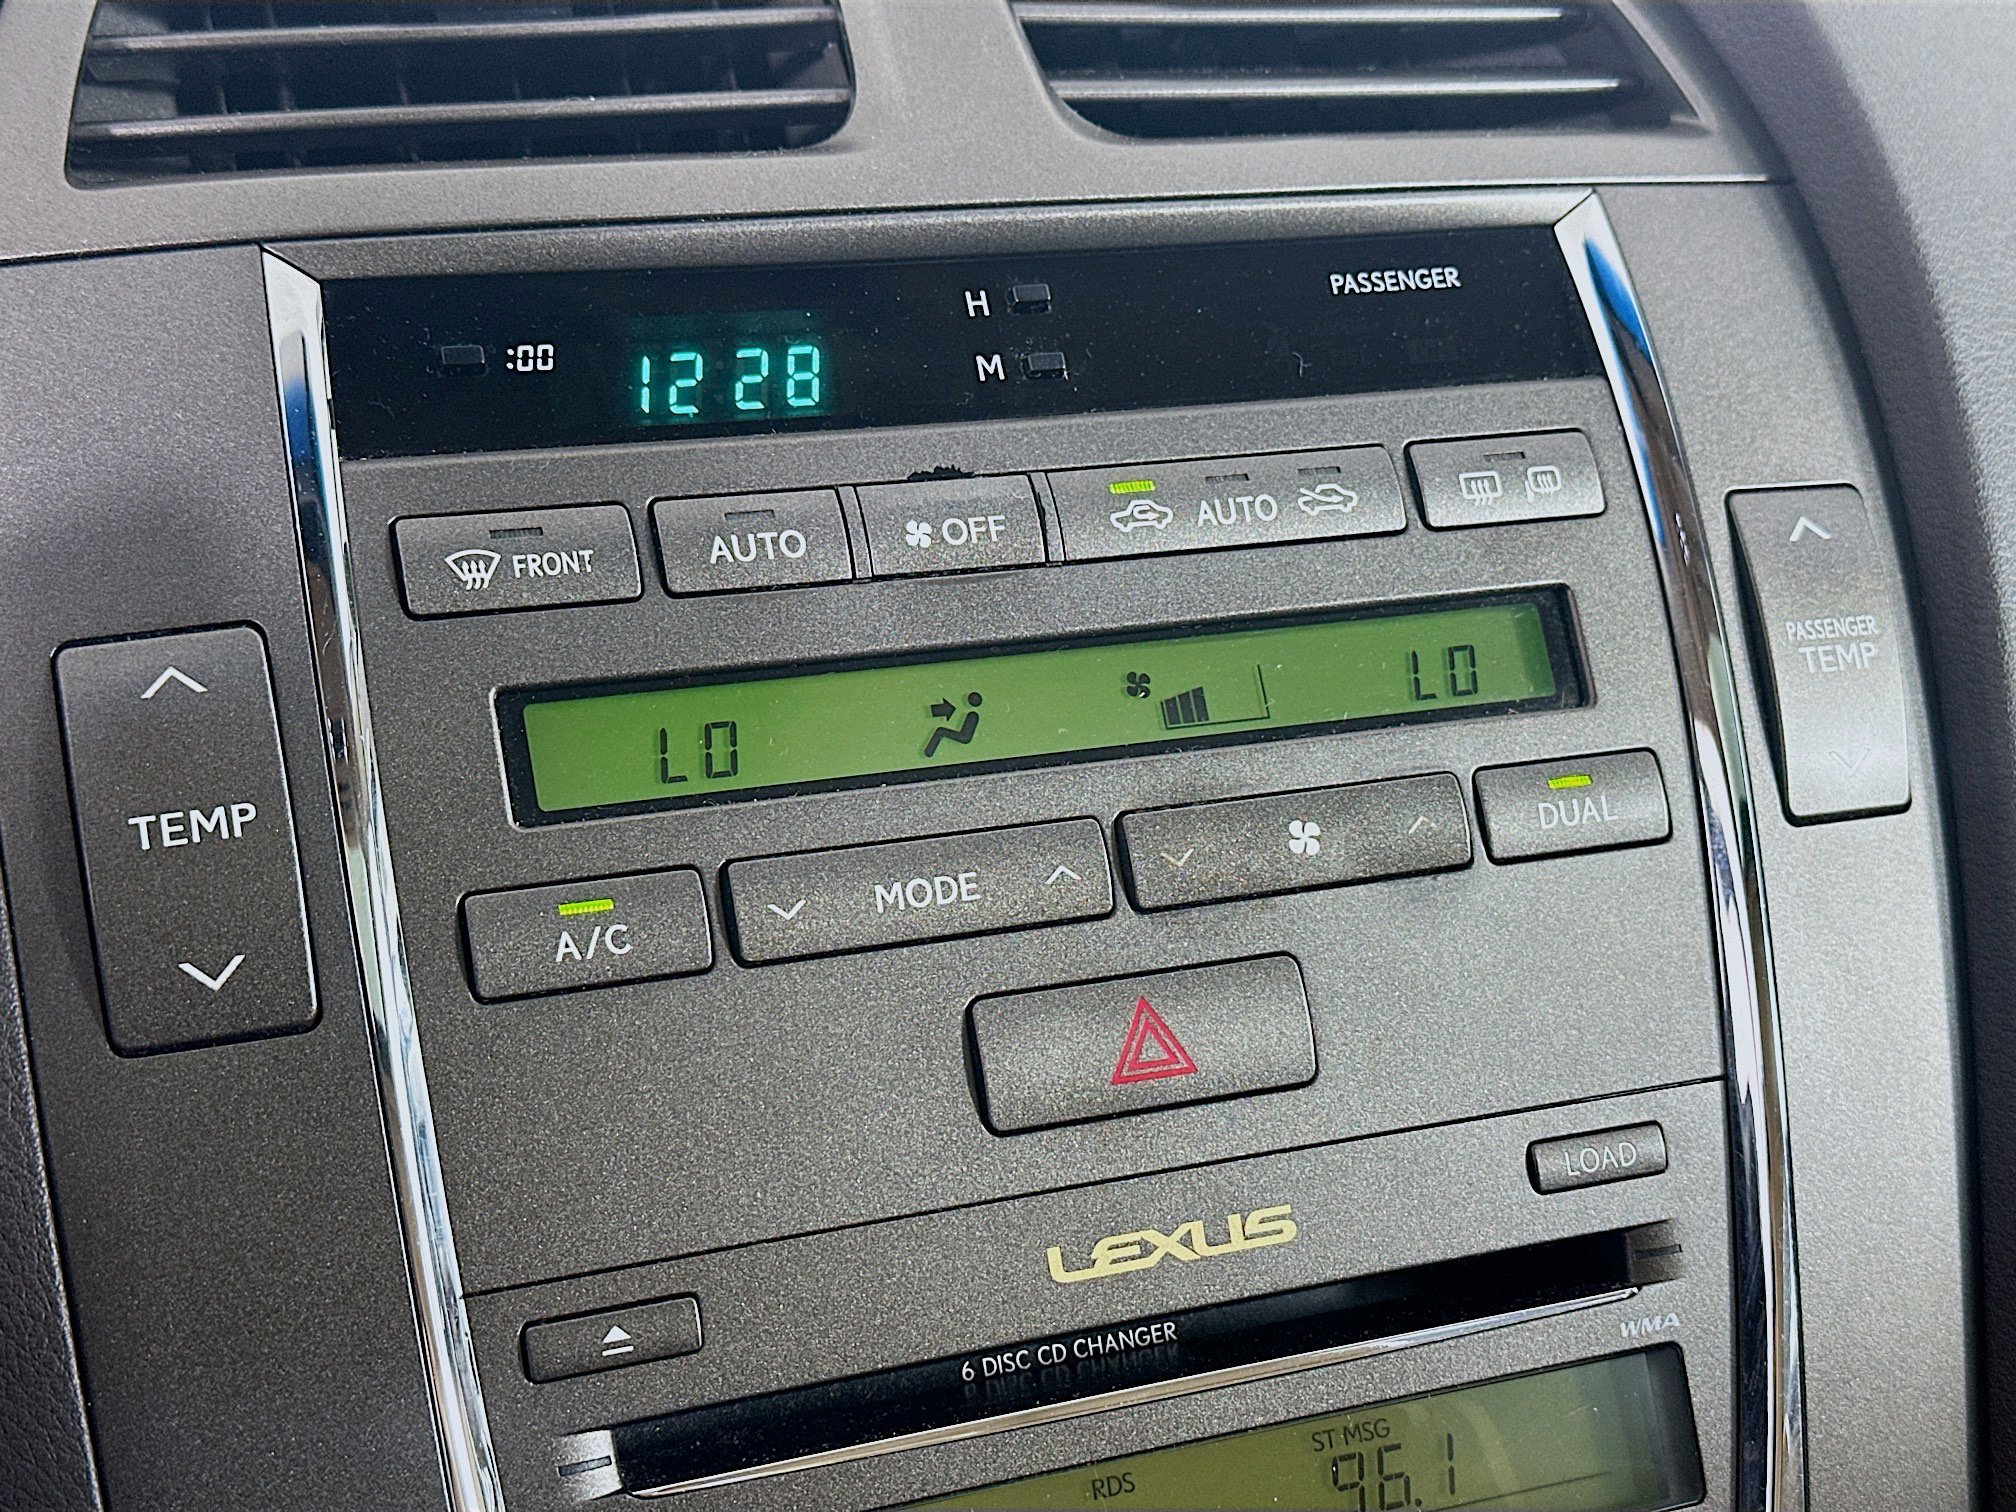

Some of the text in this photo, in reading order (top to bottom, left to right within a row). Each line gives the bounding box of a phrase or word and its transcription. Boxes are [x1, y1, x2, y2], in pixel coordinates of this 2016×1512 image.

[1329, 266, 1462, 296] PASSENGER
[964, 289, 990, 317] H
[505, 343, 555, 372] :00
[975, 354, 1005, 383] M
[1196, 494, 1279, 527] AUTO
[709, 528, 808, 564] AUTO
[941, 514, 1006, 547] OFF
[512, 548, 595, 579] FRONT
[1785, 614, 1879, 641] PASSENGER
[1409, 643, 1479, 702] LO
[1798, 641, 1879, 674] TEMP
[659, 719, 740, 785] LO
[127, 802, 258, 851] TEMP
[1537, 795, 1619, 830] DUAL
[872, 871, 979, 914] MODE
[554, 923, 633, 963] A/C
[1564, 1140, 1638, 1177] LOAD
[1045, 1203, 1299, 1284] LEXUS
[1619, 1312, 1681, 1339] WMA
[961, 1321, 1179, 1382] 6 DISC CD CHANGER
[1311, 1417, 1391, 1453] ST MSG
[1091, 1471, 1136, 1501] RDS
[1330, 1431, 1457, 1512] 96.1
